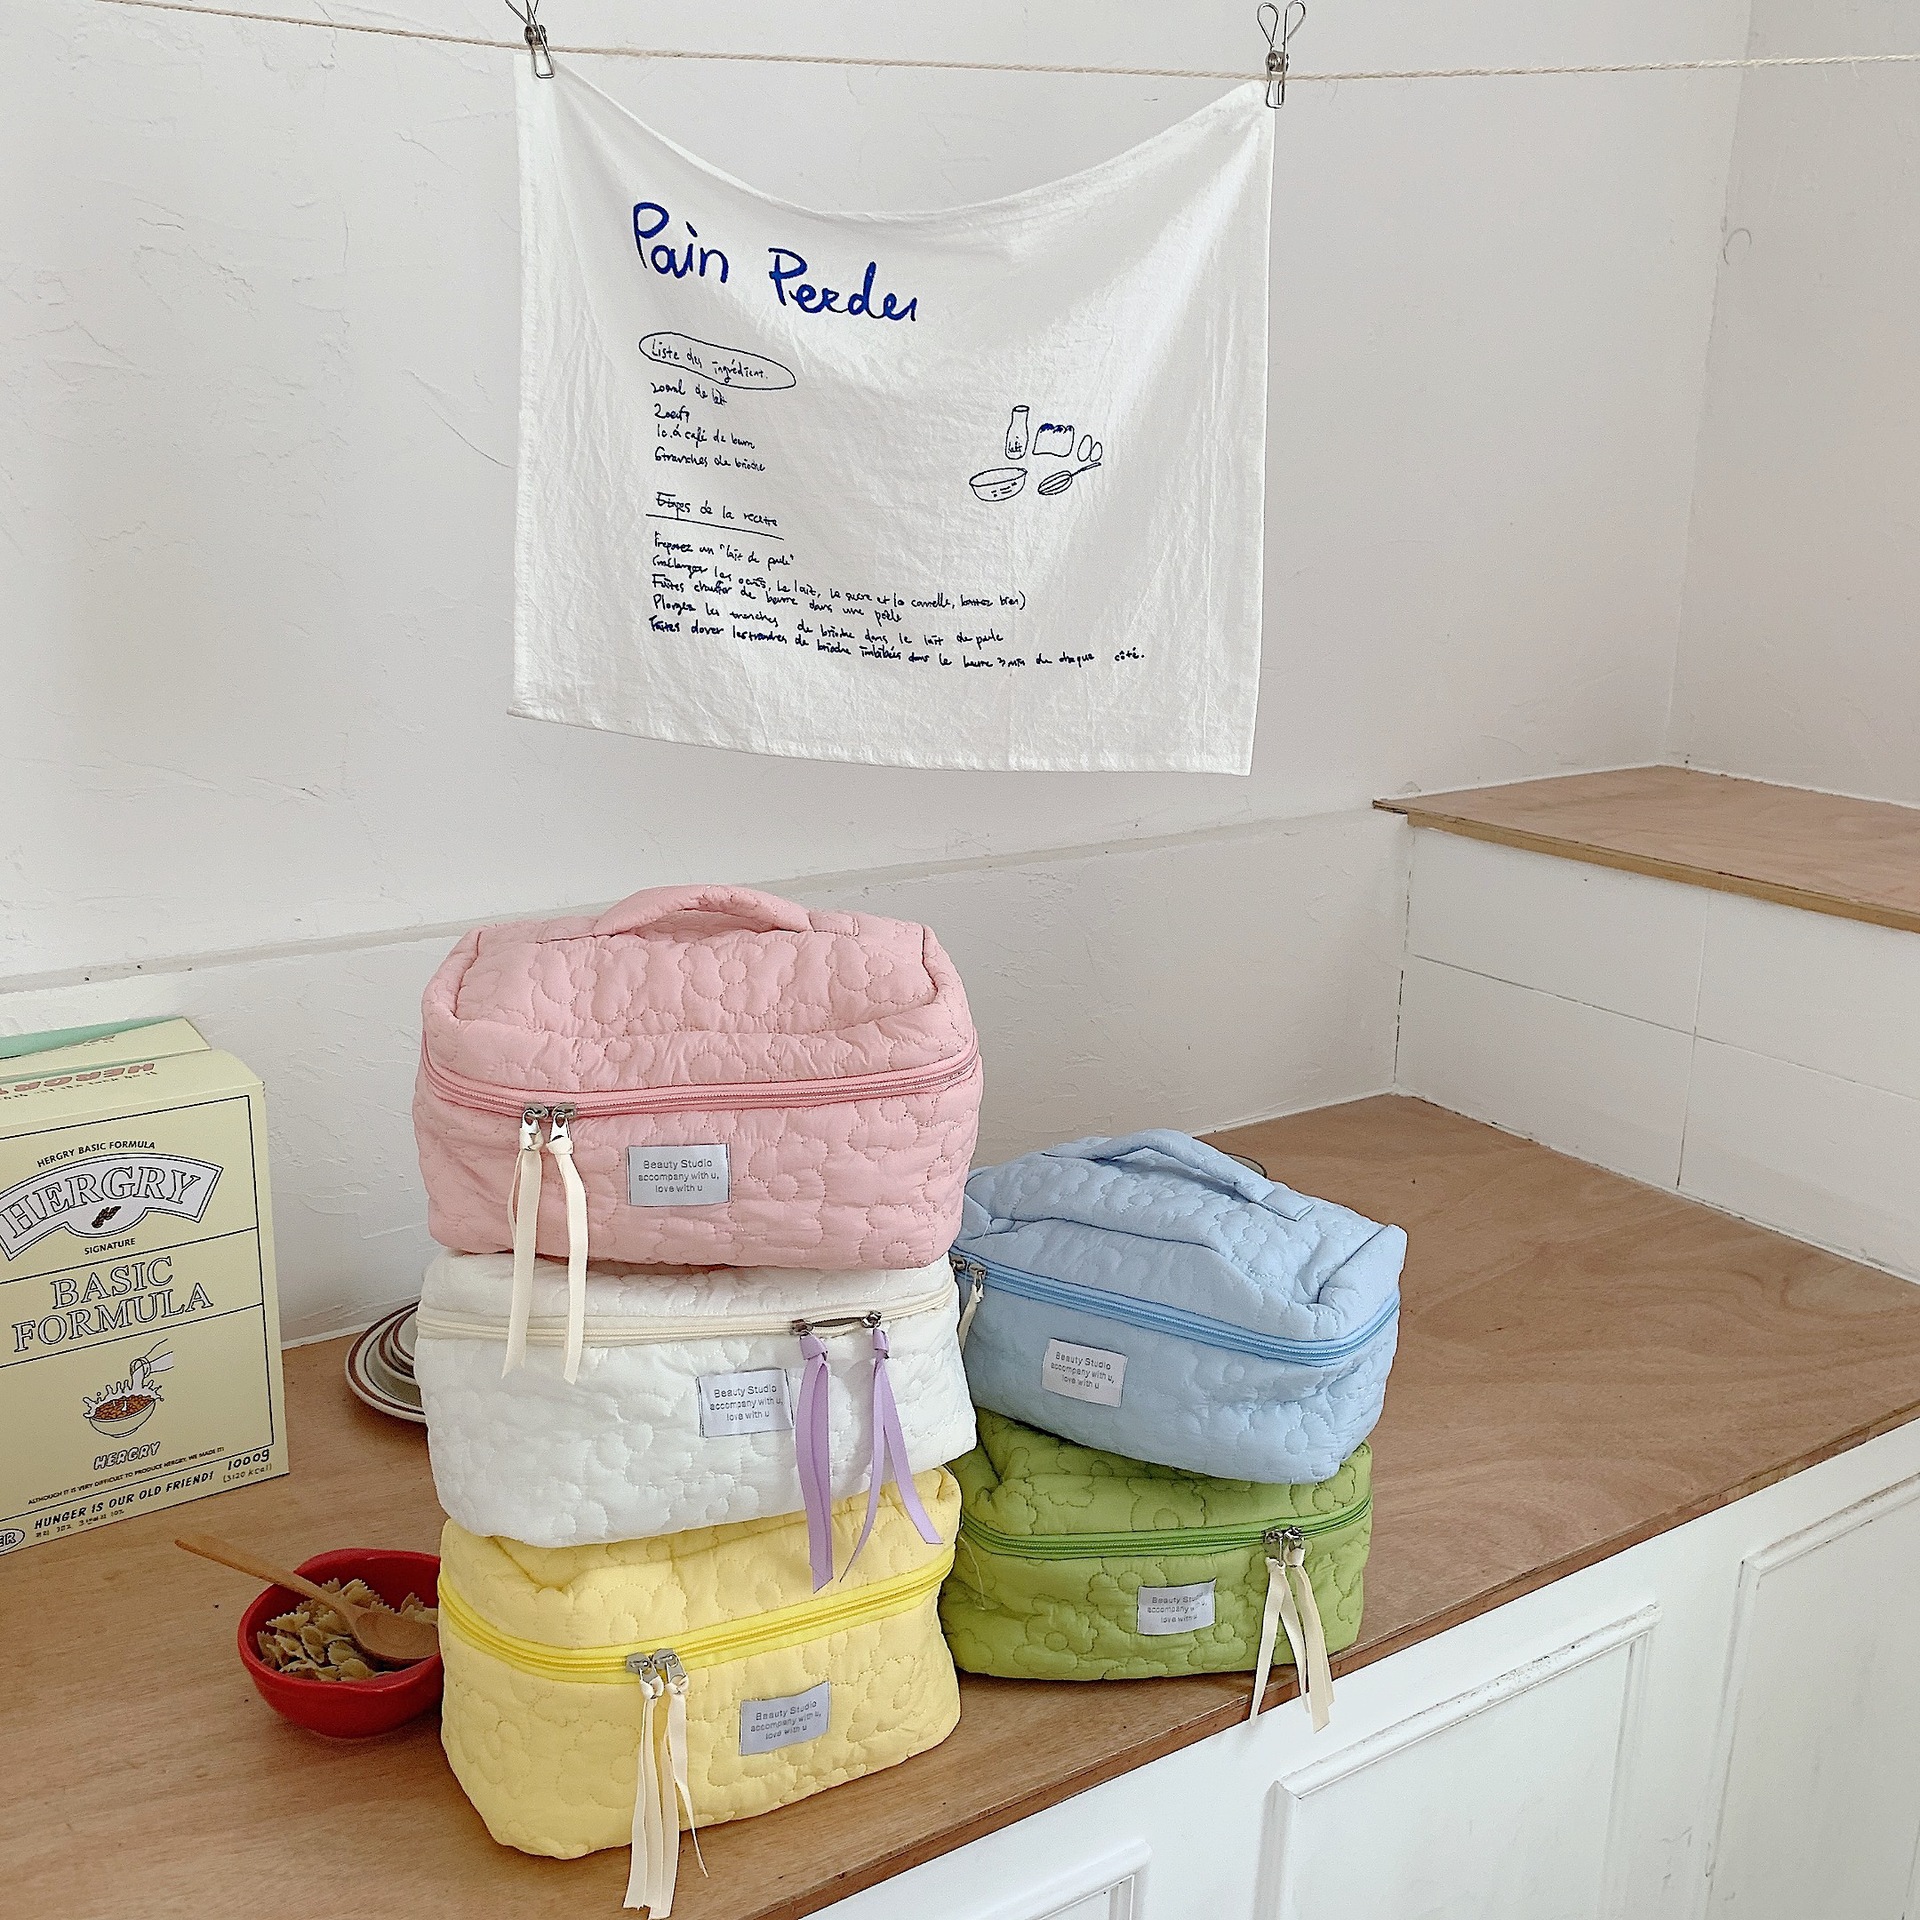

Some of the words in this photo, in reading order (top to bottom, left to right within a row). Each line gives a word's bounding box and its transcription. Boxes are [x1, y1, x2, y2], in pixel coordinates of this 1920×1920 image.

[633, 202, 729, 284] Pain
[652, 339, 680, 359] Liste
[700, 500, 713, 515] de
[722, 505, 735, 520] la
[36, 1147, 75, 1168] HERGRY
[78, 1142, 107, 1155] BASIC
[109, 1140, 156, 1149] FORMULA
[643, 1160, 679, 1171] Beauty
[681, 1158, 713, 1169] Studio
[638, 1173, 690, 1183] accompany
[690, 1171, 709, 1180] with
[655, 1185, 675, 1193] love
[676, 1184, 695, 1192] with
[0, 1165, 202, 1239] HERGRY
[84, 1237, 136, 1255] SIGNATURE
[50, 1256, 174, 1310] BASIC
[12, 1282, 214, 1353] FORMULA
[1055, 1351, 1083, 1366] Beauty
[1085, 1357, 1111, 1370] Studio
[1050, 1362, 1091, 1378] accompany
[1091, 1370, 1107, 1379] with
[1062, 1374, 1076, 1384] love
[1077, 1378, 1093, 1387] with
[714, 1387, 745, 1399] Beauty
[747, 1384, 777, 1395] Studio
[709, 1399, 757, 1411] accompany
[758, 1396, 775, 1406] with
[726, 1412, 744, 1421] love
[744, 1410, 763, 1420] with
[93, 1441, 161, 1471] HERGRY
[227, 1448, 270, 1471] 1000g
[134, 1463, 163, 1477] PRODUCE
[34, 1507, 87, 1529] HUNGER
[91, 1502, 104, 1513] IS
[109, 1493, 134, 1508] OUR
[139, 1486, 162, 1500] OLD
[166, 1470, 214, 1493] FRIEND!
[1152, 1596, 1181, 1604] Beauty
[1147, 1606, 1190, 1614] accompany
[755, 1709, 788, 1721] Beauty
[790, 1700, 817, 1715] Studio
[751, 1717, 797, 1732] accompany
[798, 1713, 814, 1723] with
[765, 1729, 782, 1740] love
[784, 1726, 801, 1735] with
